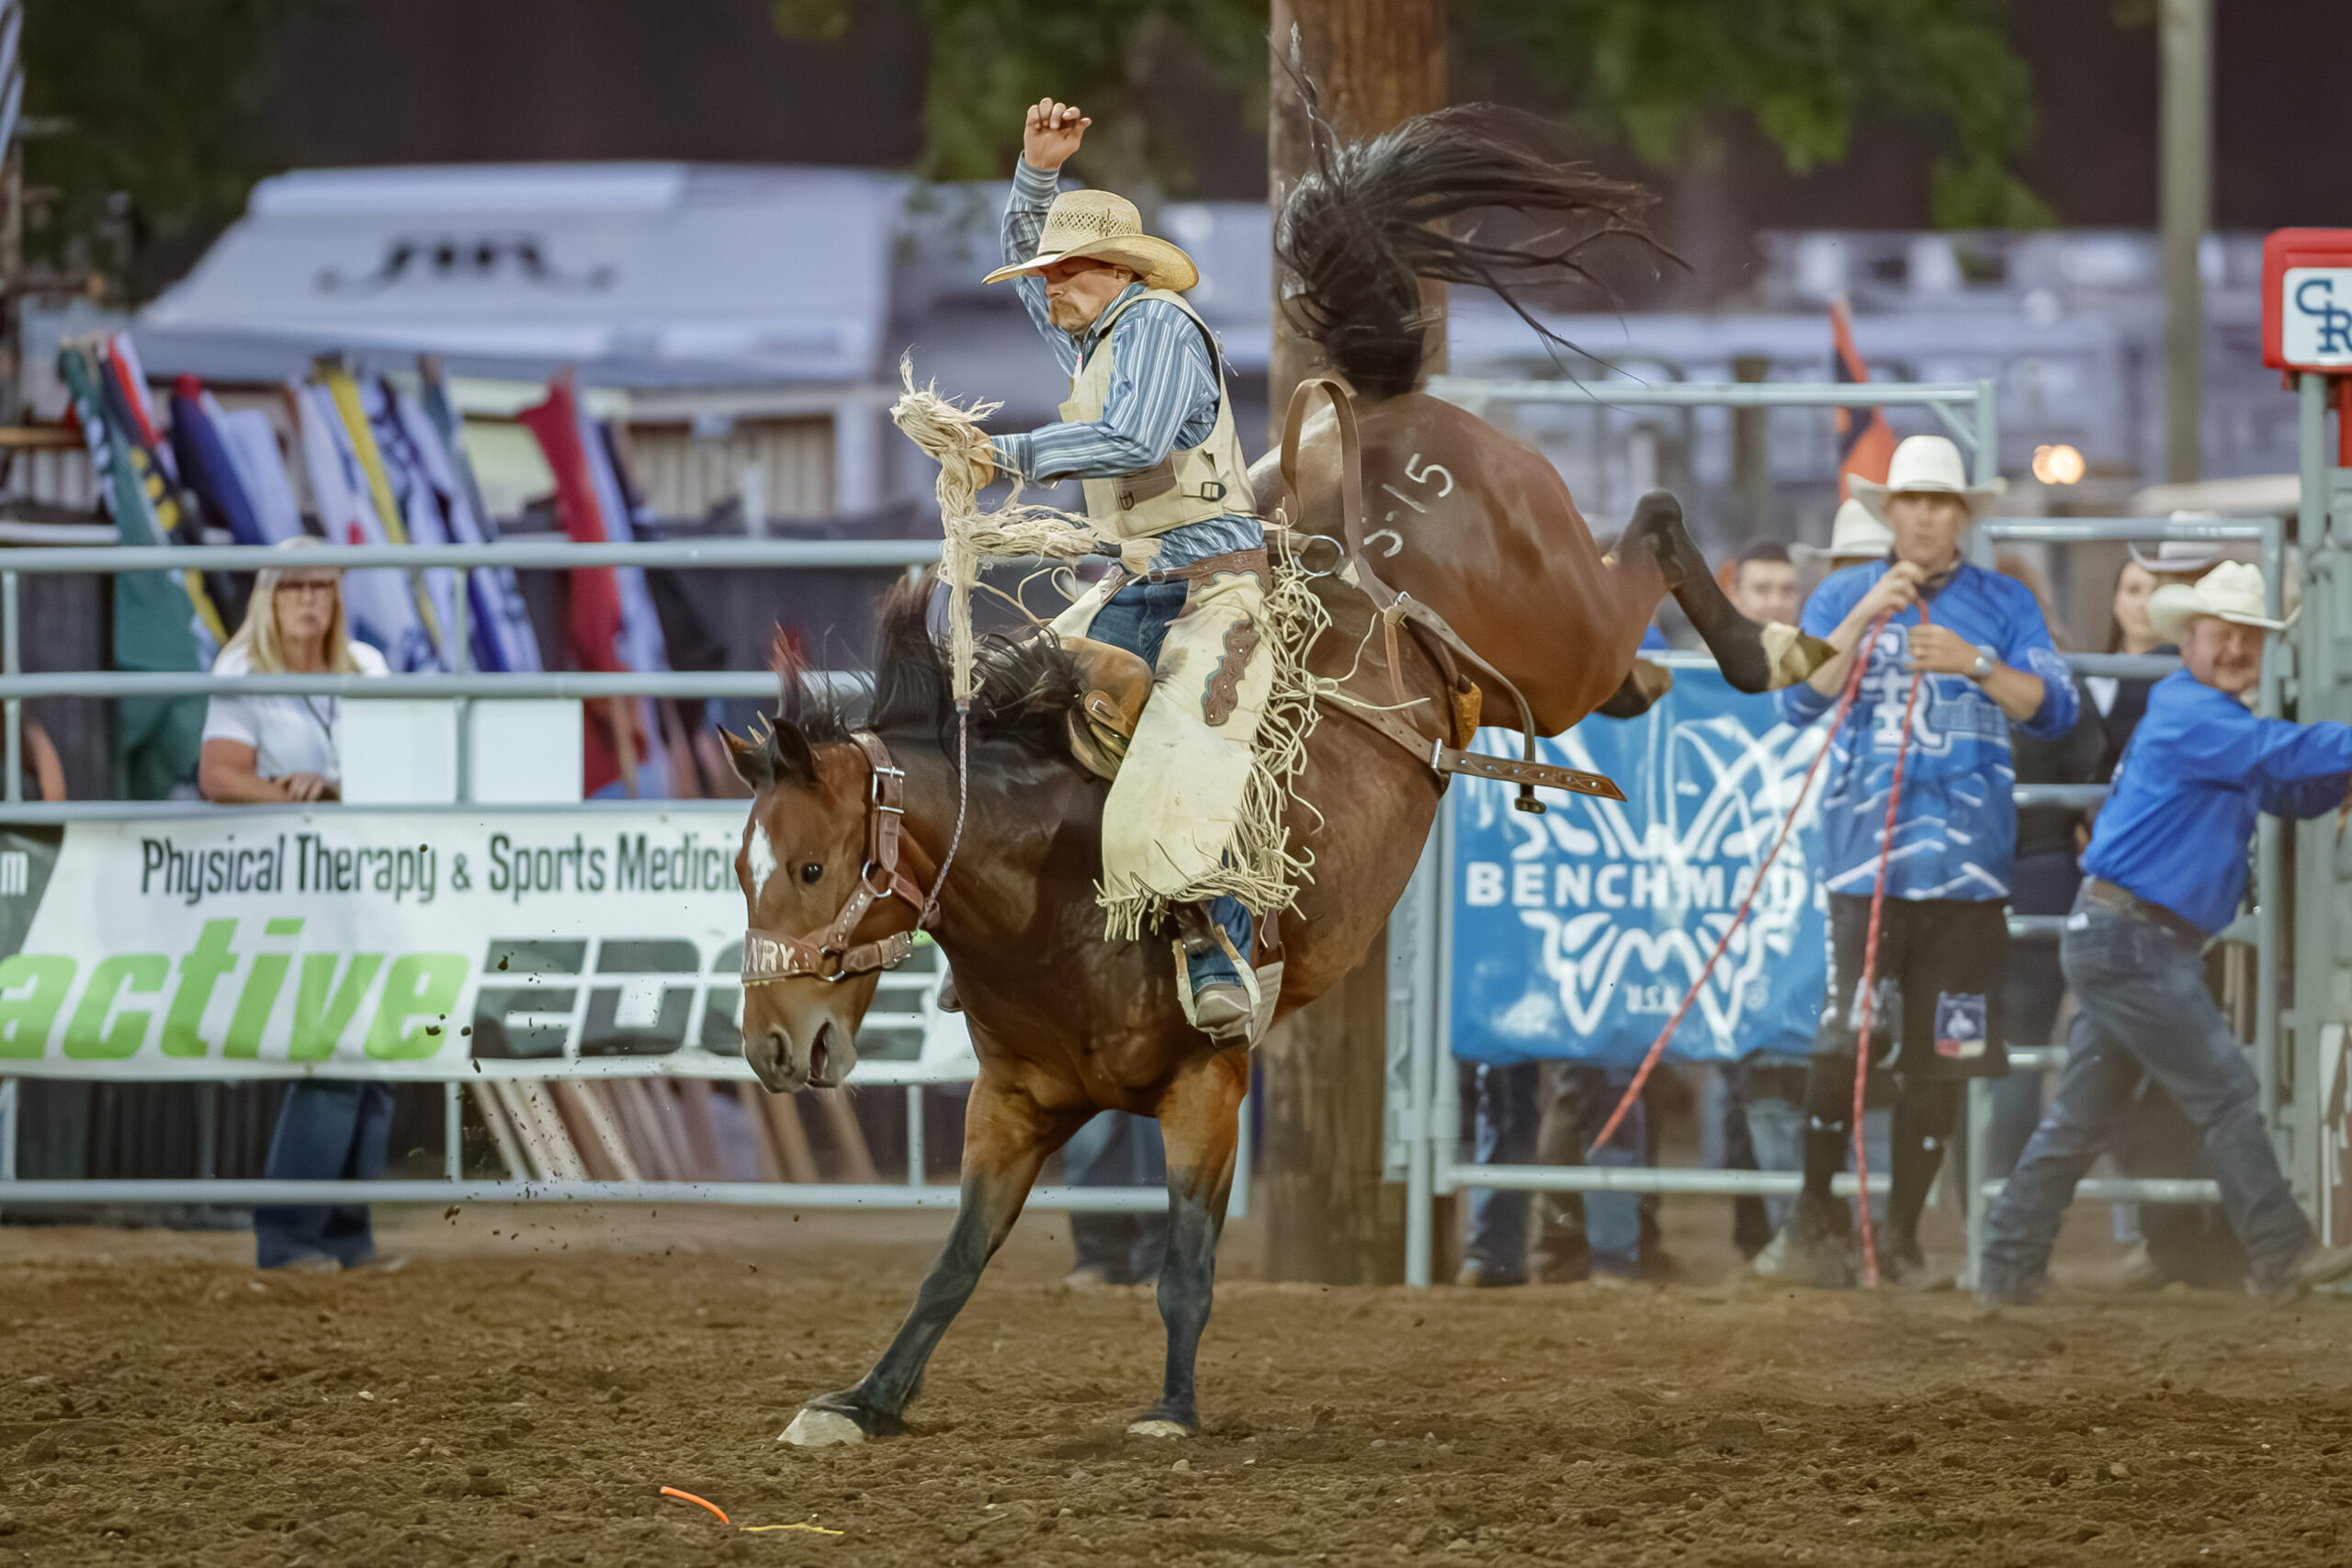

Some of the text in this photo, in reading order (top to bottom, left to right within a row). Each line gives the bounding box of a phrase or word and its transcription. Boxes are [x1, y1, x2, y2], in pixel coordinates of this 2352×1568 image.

[141, 832, 741, 907] Physical Therapy & Sports Medici
[0, 918, 469, 1060] active
